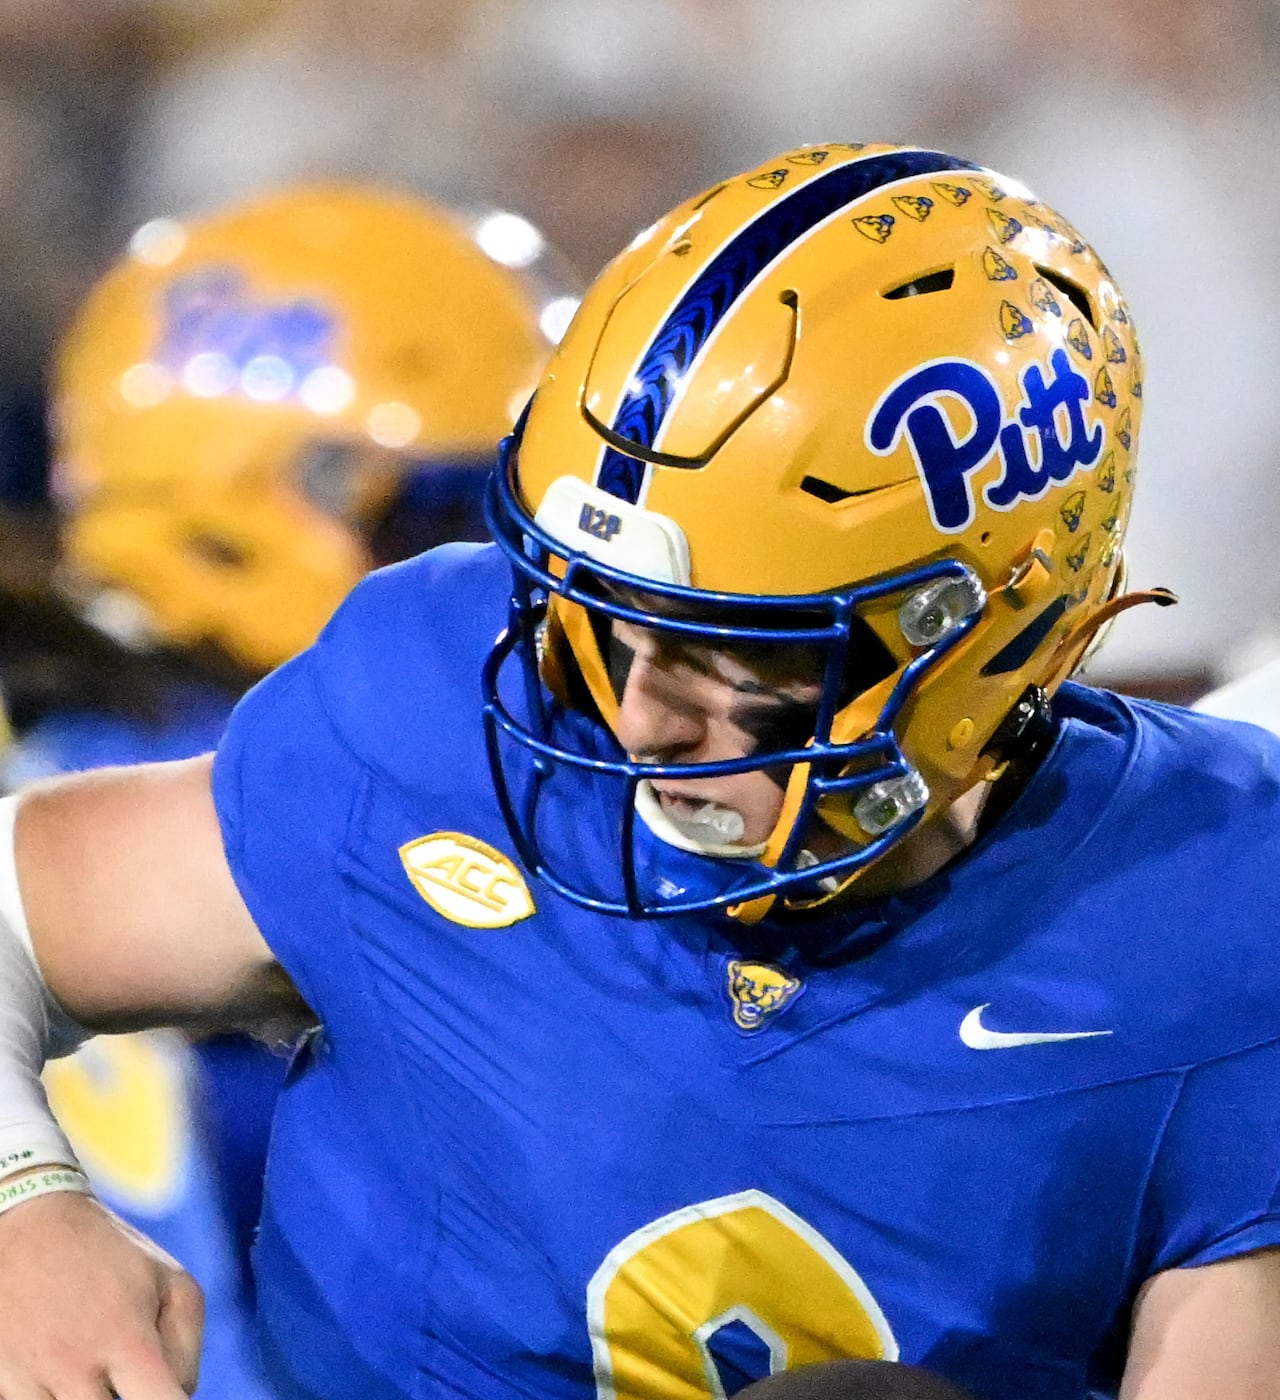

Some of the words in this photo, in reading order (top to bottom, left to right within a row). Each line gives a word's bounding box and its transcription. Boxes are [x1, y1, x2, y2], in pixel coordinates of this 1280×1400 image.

[864, 347, 1106, 536] Pitt
[578, 502, 622, 543] H2P
[422, 853, 521, 906] ACC
